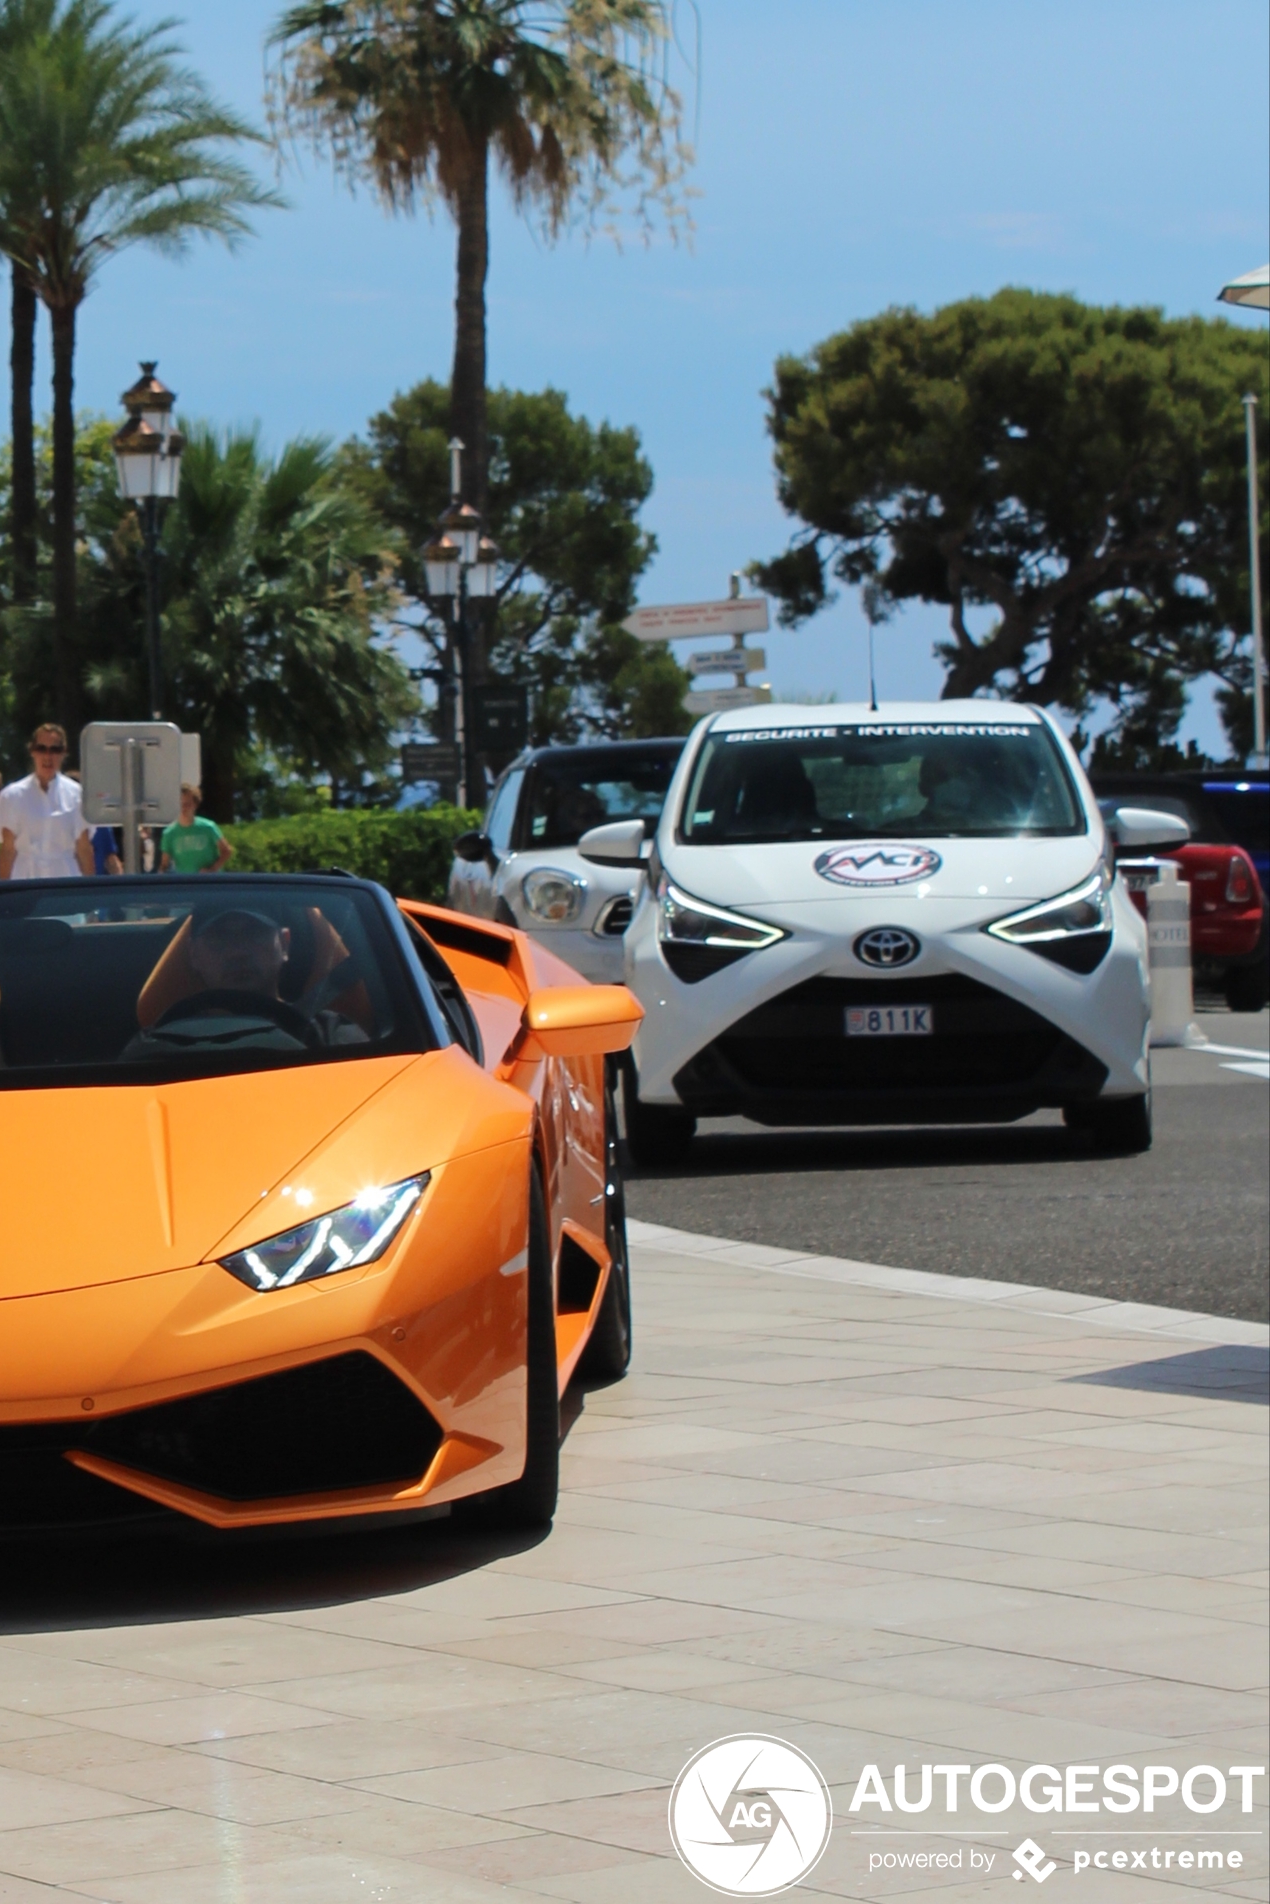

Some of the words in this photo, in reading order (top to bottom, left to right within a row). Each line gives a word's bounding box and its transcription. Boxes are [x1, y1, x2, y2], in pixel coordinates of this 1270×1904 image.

[725, 726, 837, 743] SECURITE
[858, 725, 1030, 737] INTERVENTION
[868, 1010, 928, 1033] 811K
